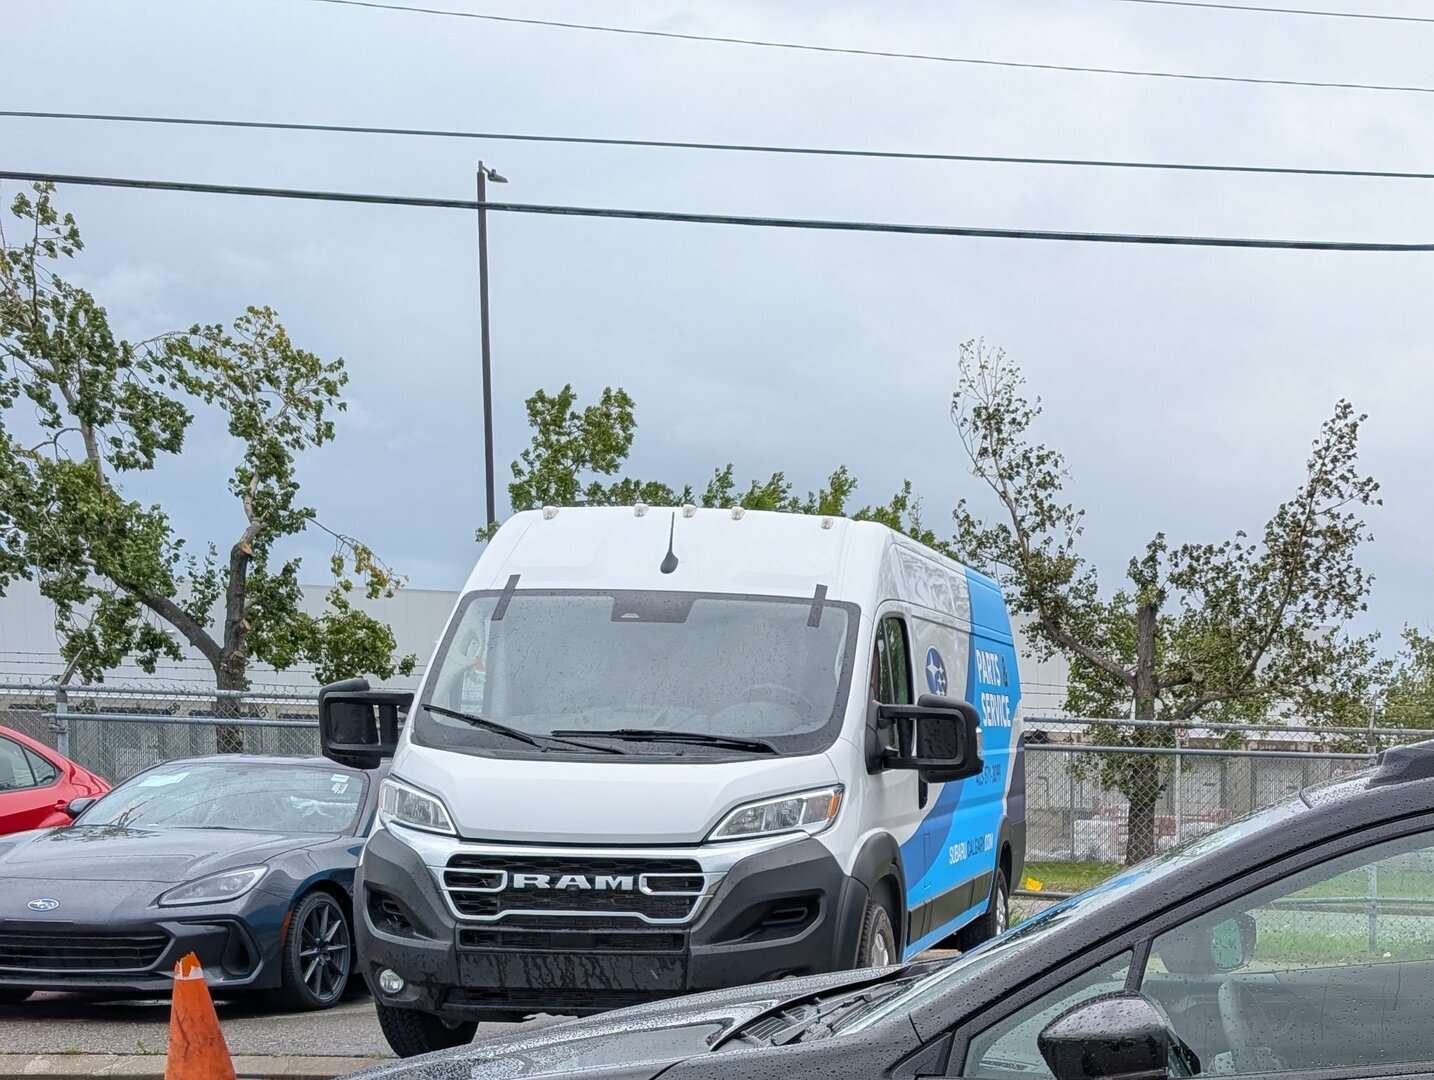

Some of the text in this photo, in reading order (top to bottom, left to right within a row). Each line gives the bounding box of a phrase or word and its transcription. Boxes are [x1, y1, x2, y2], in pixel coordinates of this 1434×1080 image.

[975, 649, 1001, 686] PARTS
[981, 692, 1011, 727] SERVICE
[513, 873, 634, 891] RAM
